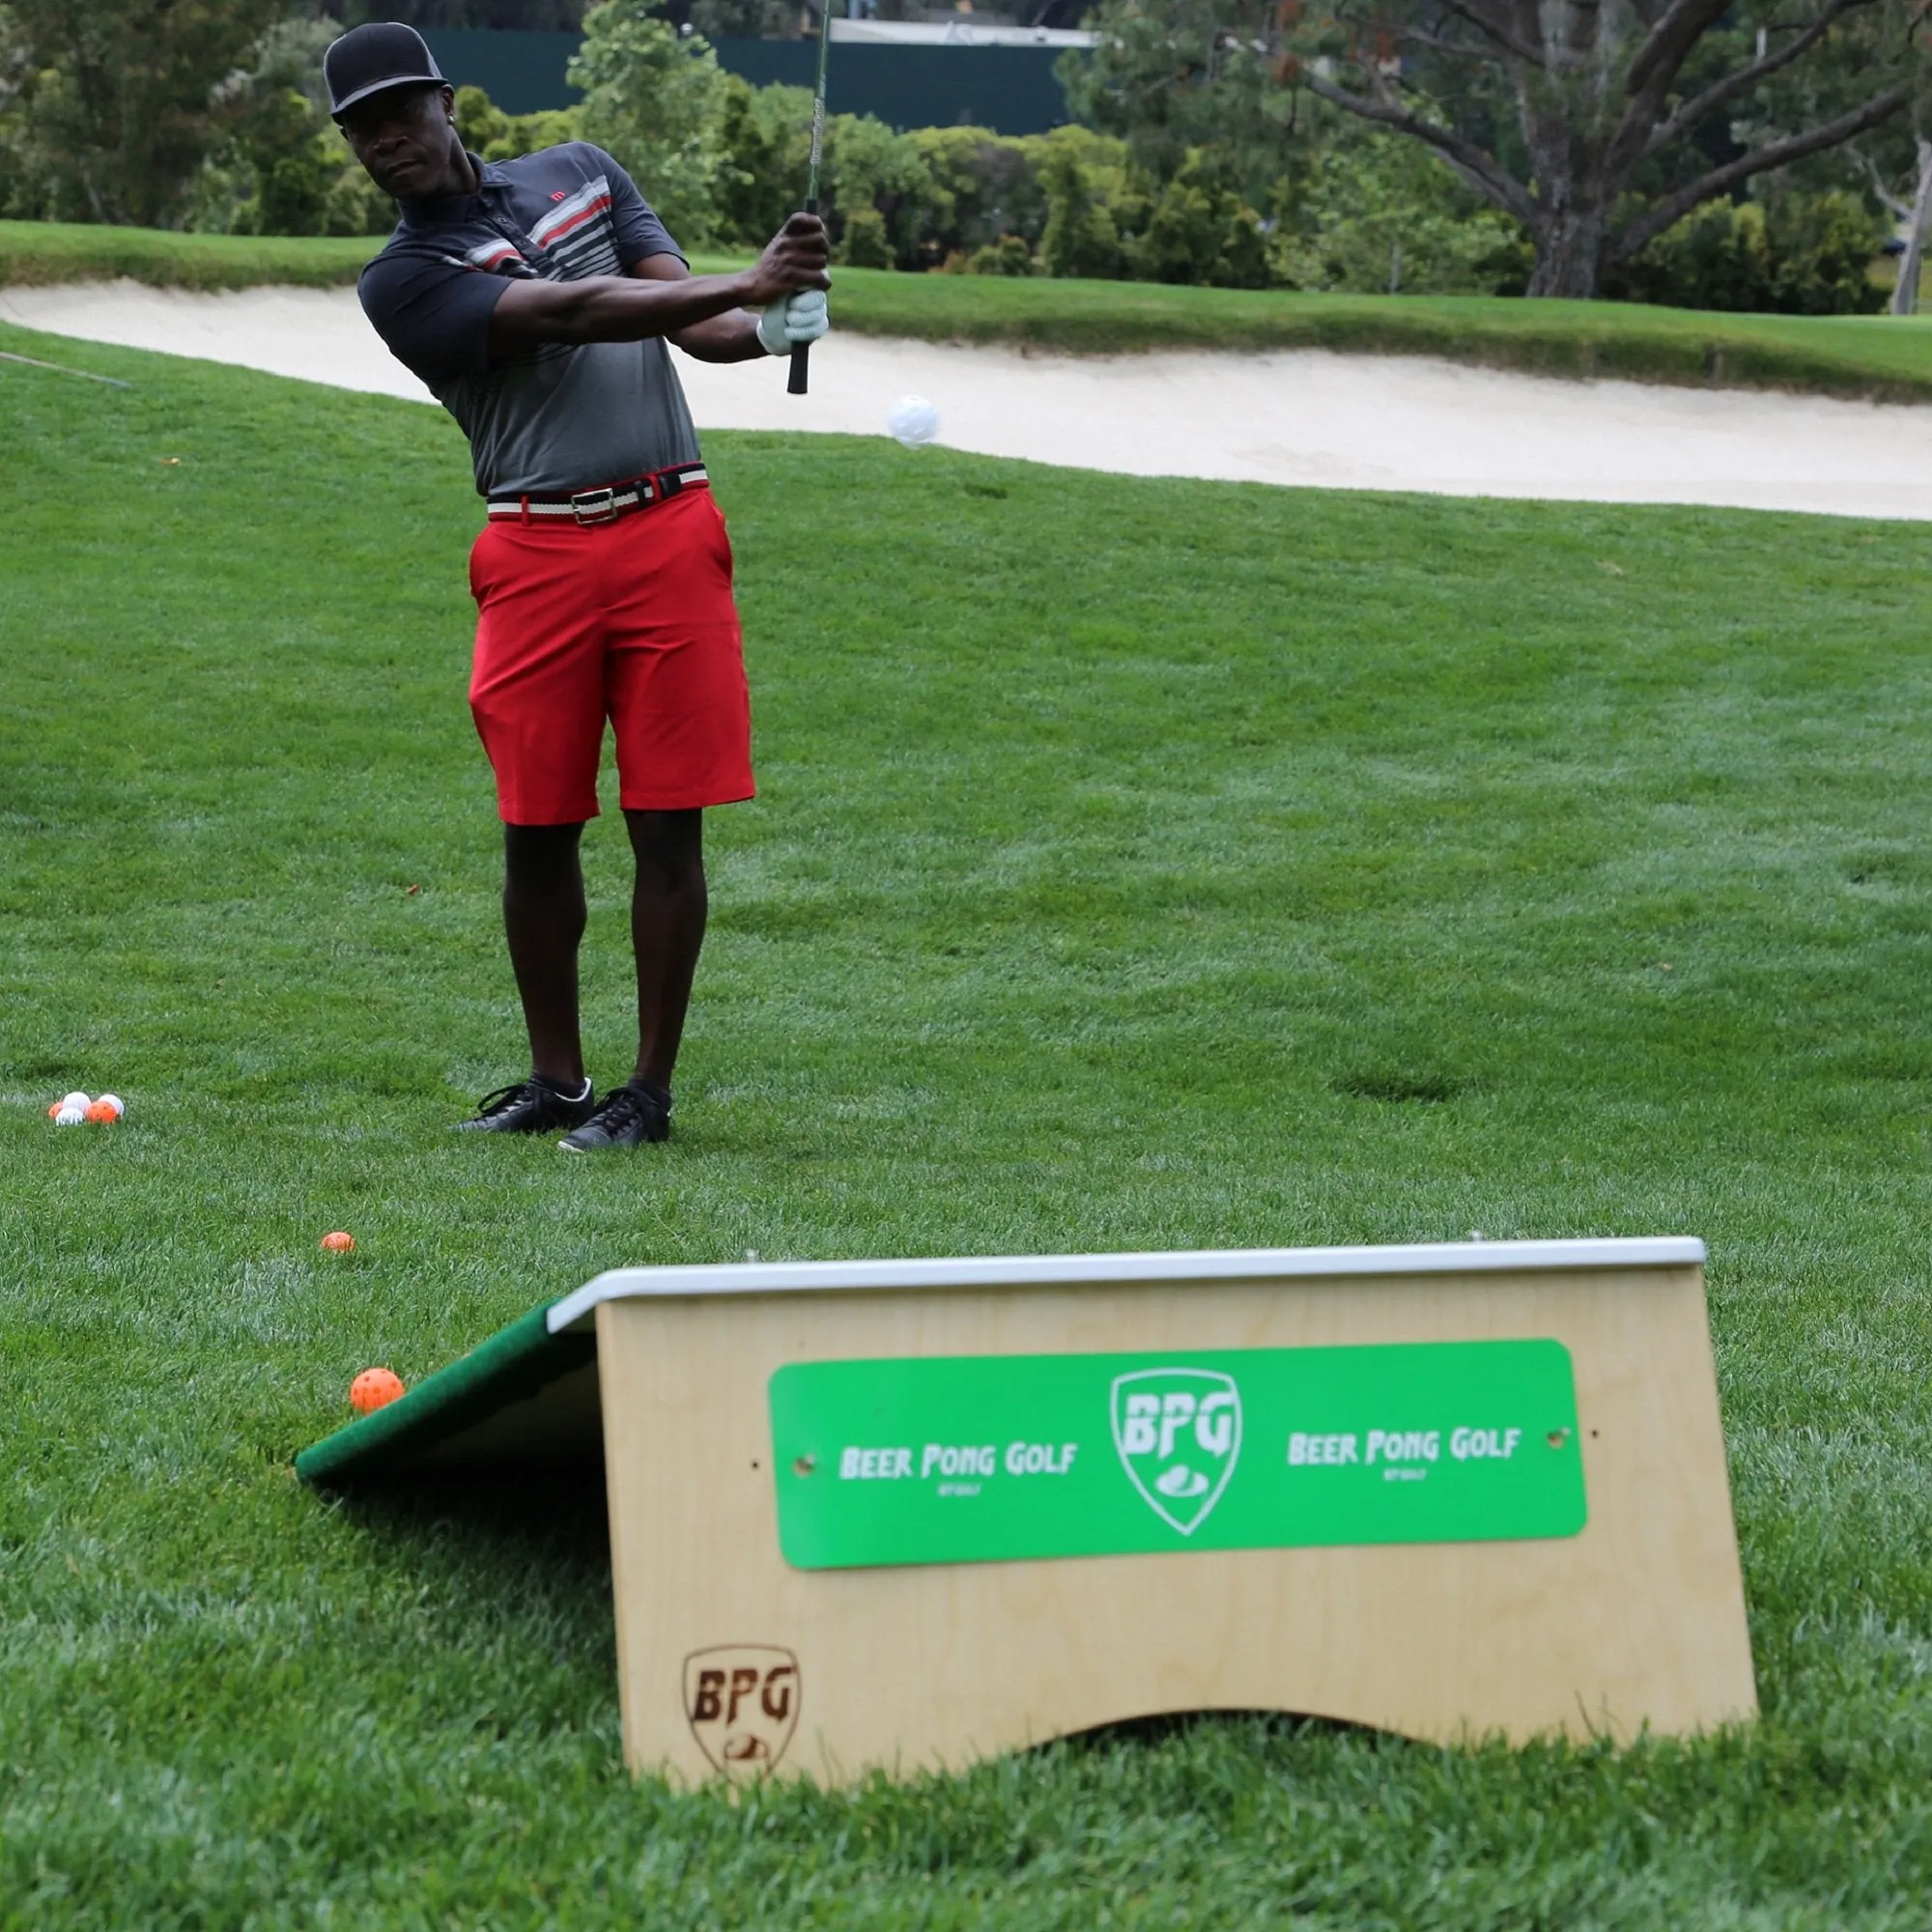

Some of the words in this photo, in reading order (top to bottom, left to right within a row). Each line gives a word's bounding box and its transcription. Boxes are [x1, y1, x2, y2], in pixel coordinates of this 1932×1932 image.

[1123, 1391, 1236, 1459] BPG
[1288, 1432, 1358, 1465] BEER
[1365, 1430, 1439, 1464] PONG
[1450, 1427, 1521, 1461] GOLF
[839, 1445, 913, 1480] BEER
[921, 1442, 996, 1479] PONG
[1005, 1440, 1078, 1476] GOLF
[693, 1666, 795, 1724] BPG
